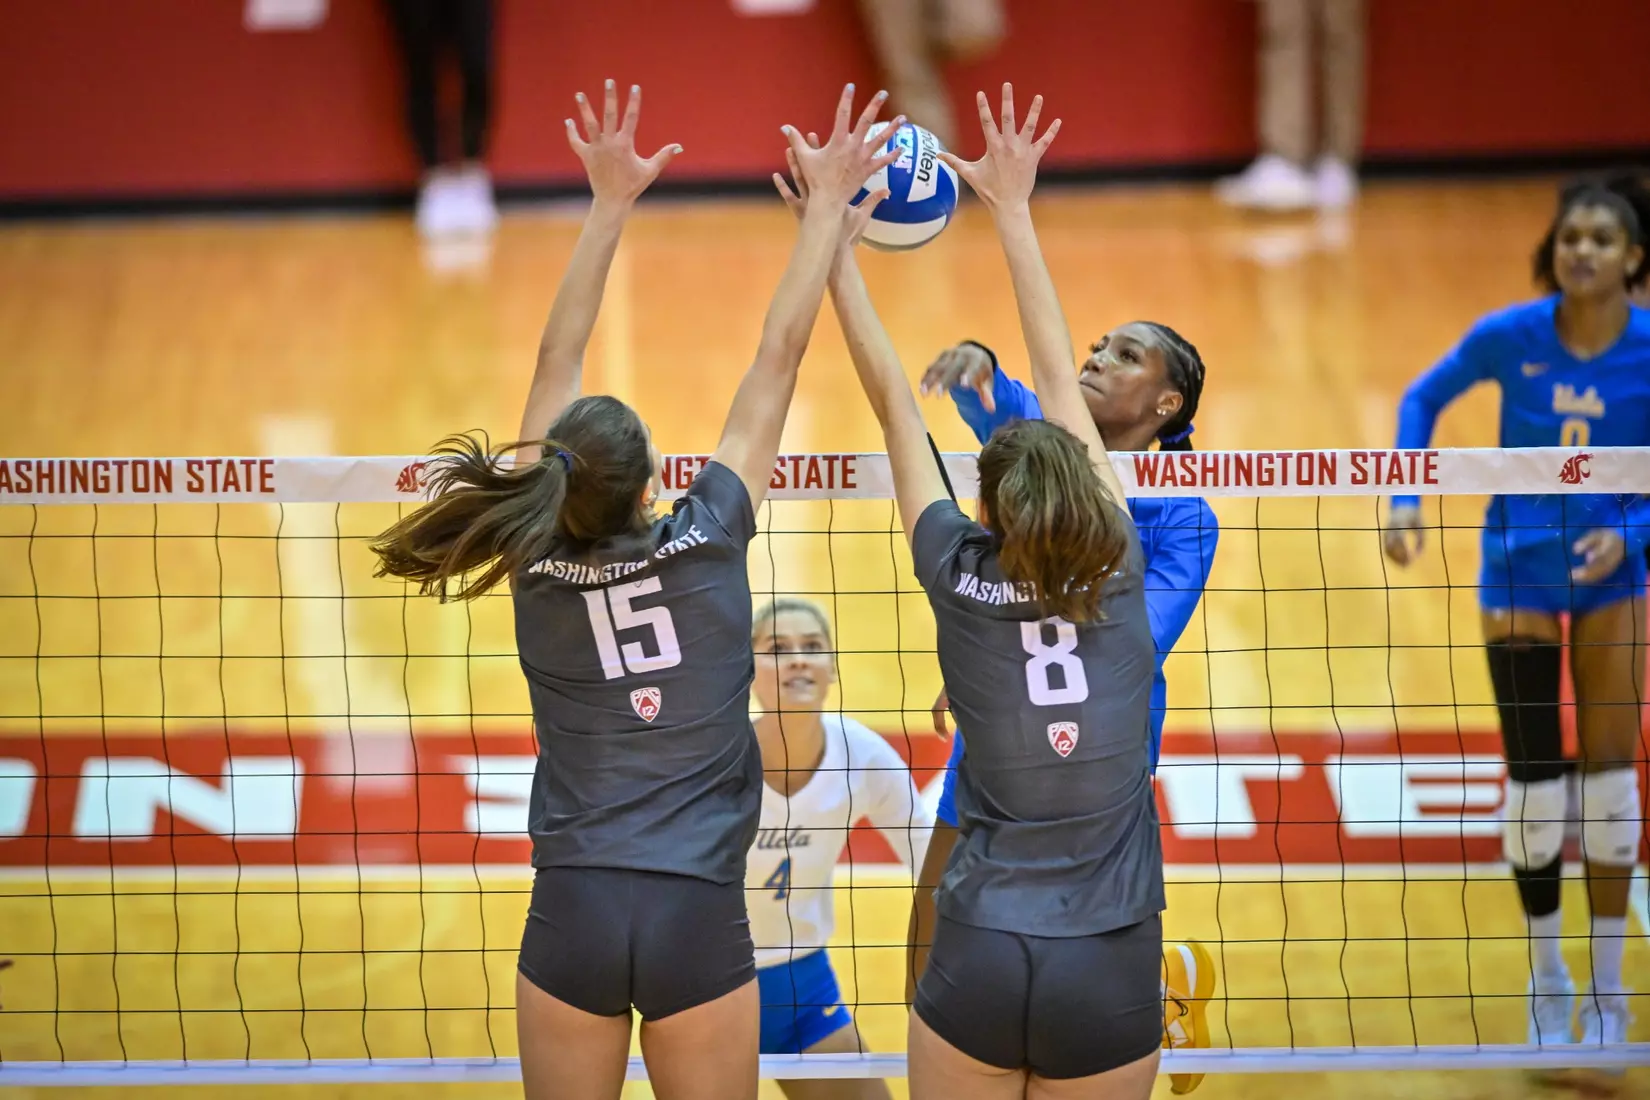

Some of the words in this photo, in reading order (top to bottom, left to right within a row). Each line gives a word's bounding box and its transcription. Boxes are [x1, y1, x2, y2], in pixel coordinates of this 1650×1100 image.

[0, 459, 172, 493] ASHINGTON
[185, 459, 275, 493] STATE
[768, 455, 857, 489] STATE
[1132, 452, 1337, 487] WASHINGTON
[1350, 451, 1439, 485] STATE
[654, 524, 709, 560] STATE
[579, 575, 682, 680] 15
[1020, 615, 1089, 706] 8
[763, 856, 792, 901] 4
